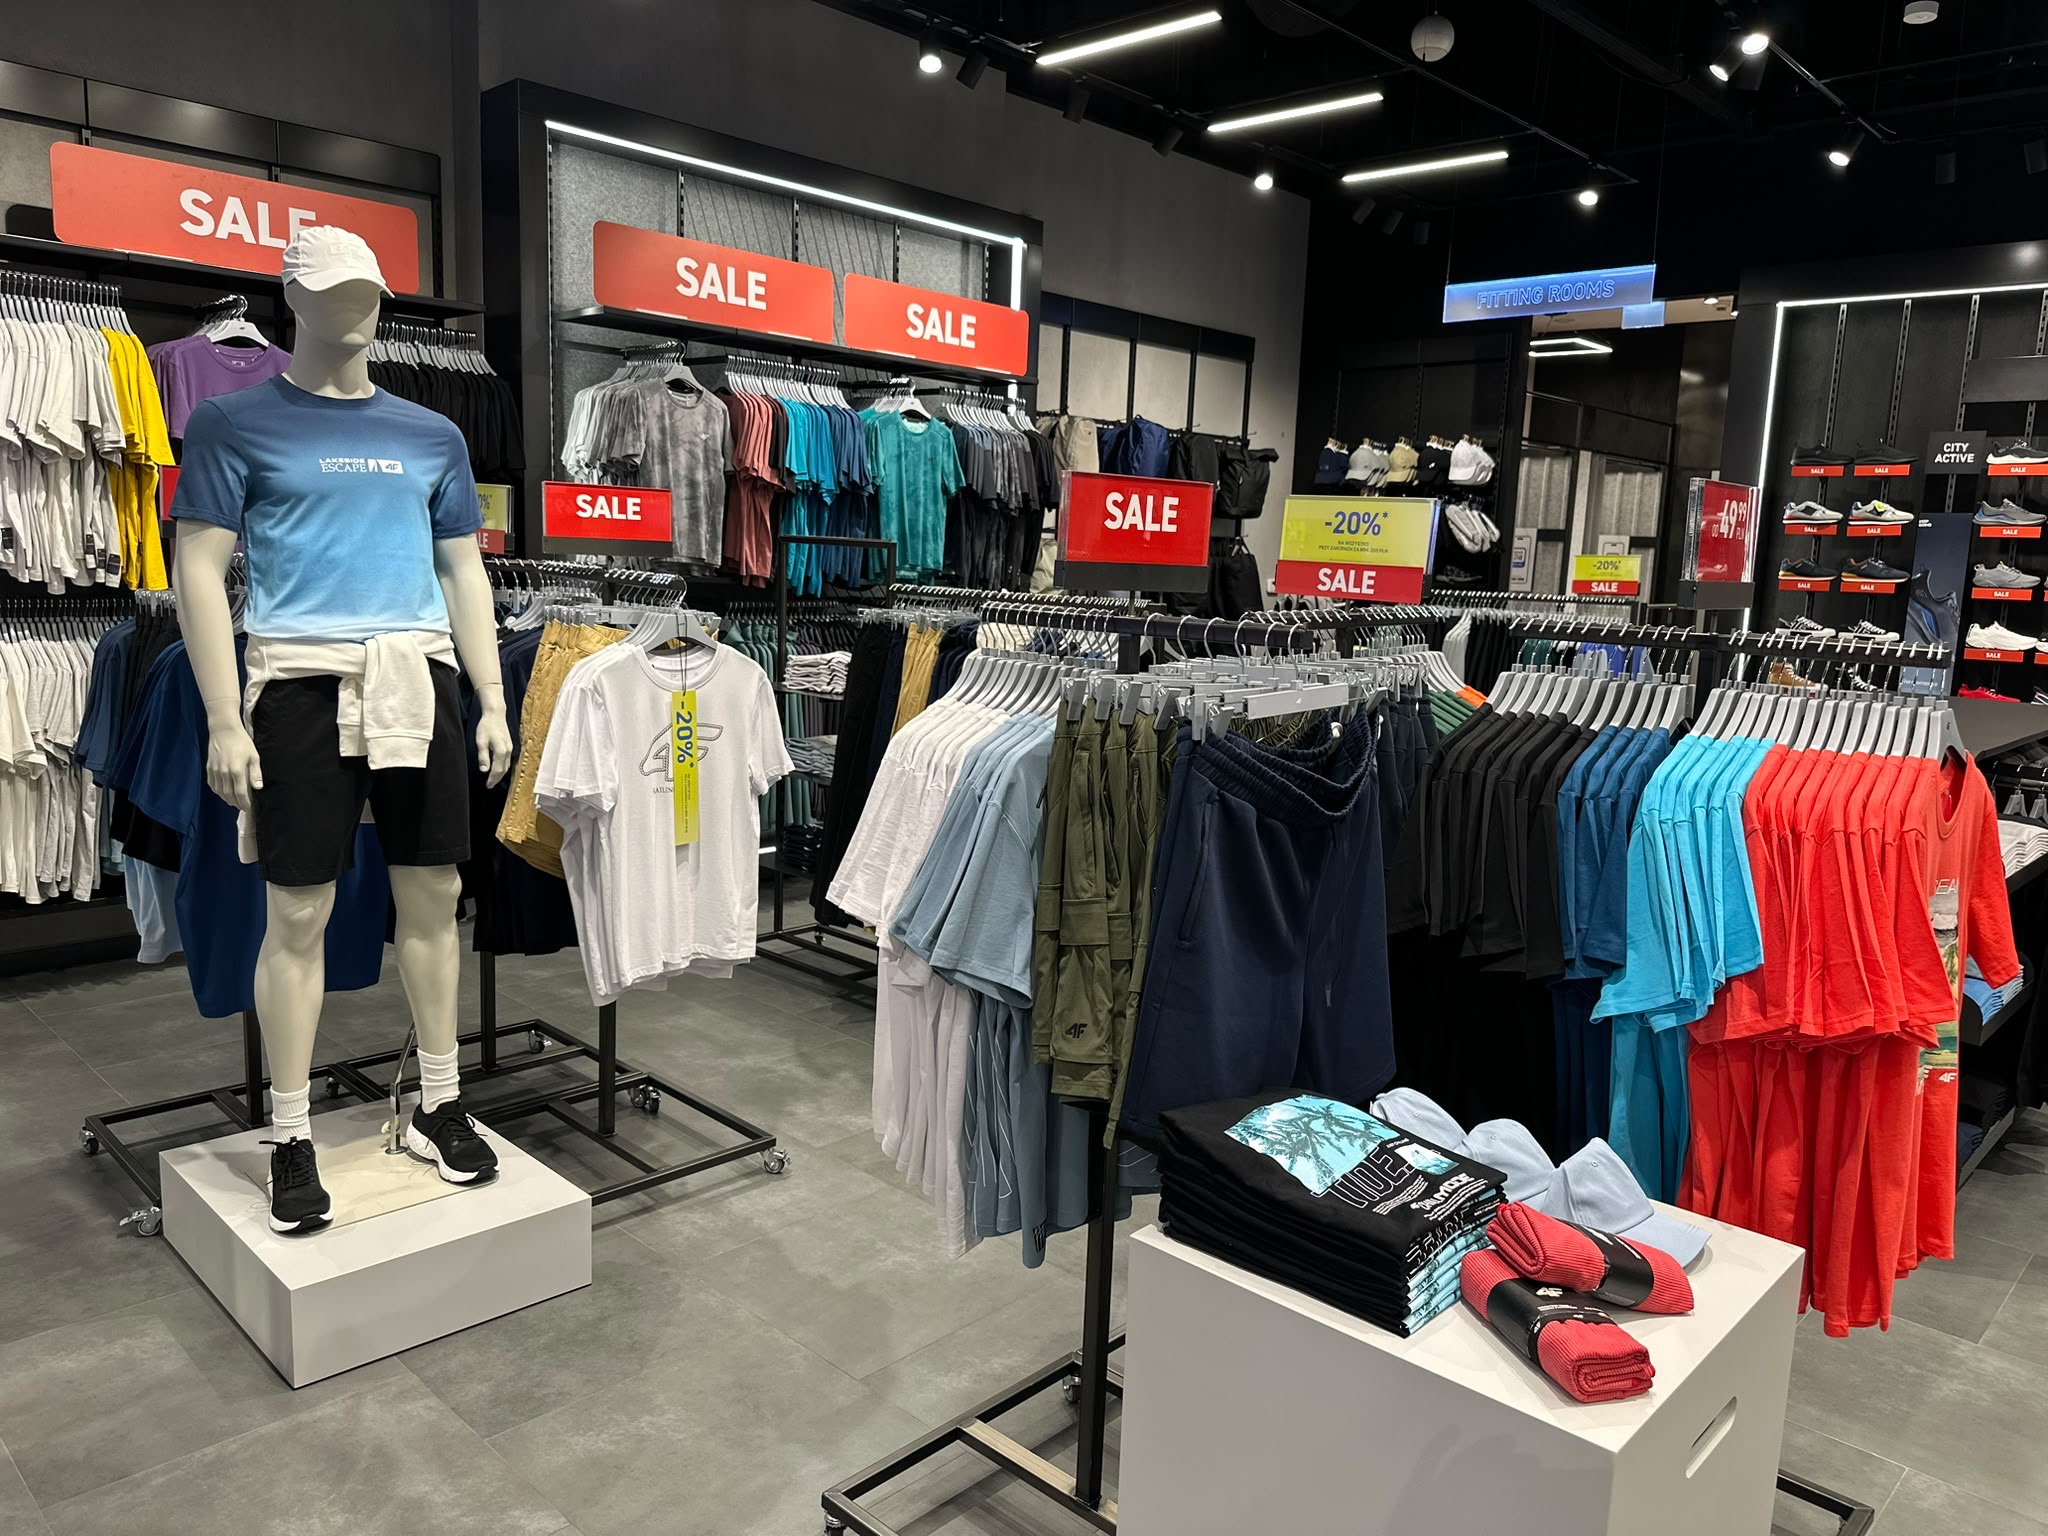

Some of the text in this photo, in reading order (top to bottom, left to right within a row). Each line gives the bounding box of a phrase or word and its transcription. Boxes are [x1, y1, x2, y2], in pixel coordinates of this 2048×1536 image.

[675, 256, 767, 311] SALE
[1476, 280, 1615, 309] FITTING ROOMS
[905, 303, 977, 349] SALE
[1943, 442, 1969, 452] CITY
[1934, 453, 1975, 463] ACTIVE
[321, 463, 399, 473] ESCAPE 4F
[575, 493, 642, 521] SALE
[1103, 491, 1180, 532] SALE
[1316, 567, 1377, 595] SALE
[1591, 582, 1619, 593] SALE
[1064, 1022, 1088, 1039] 4F
[1938, 1071, 1958, 1083] 4F
[1535, 1287, 1563, 1297] 4F
